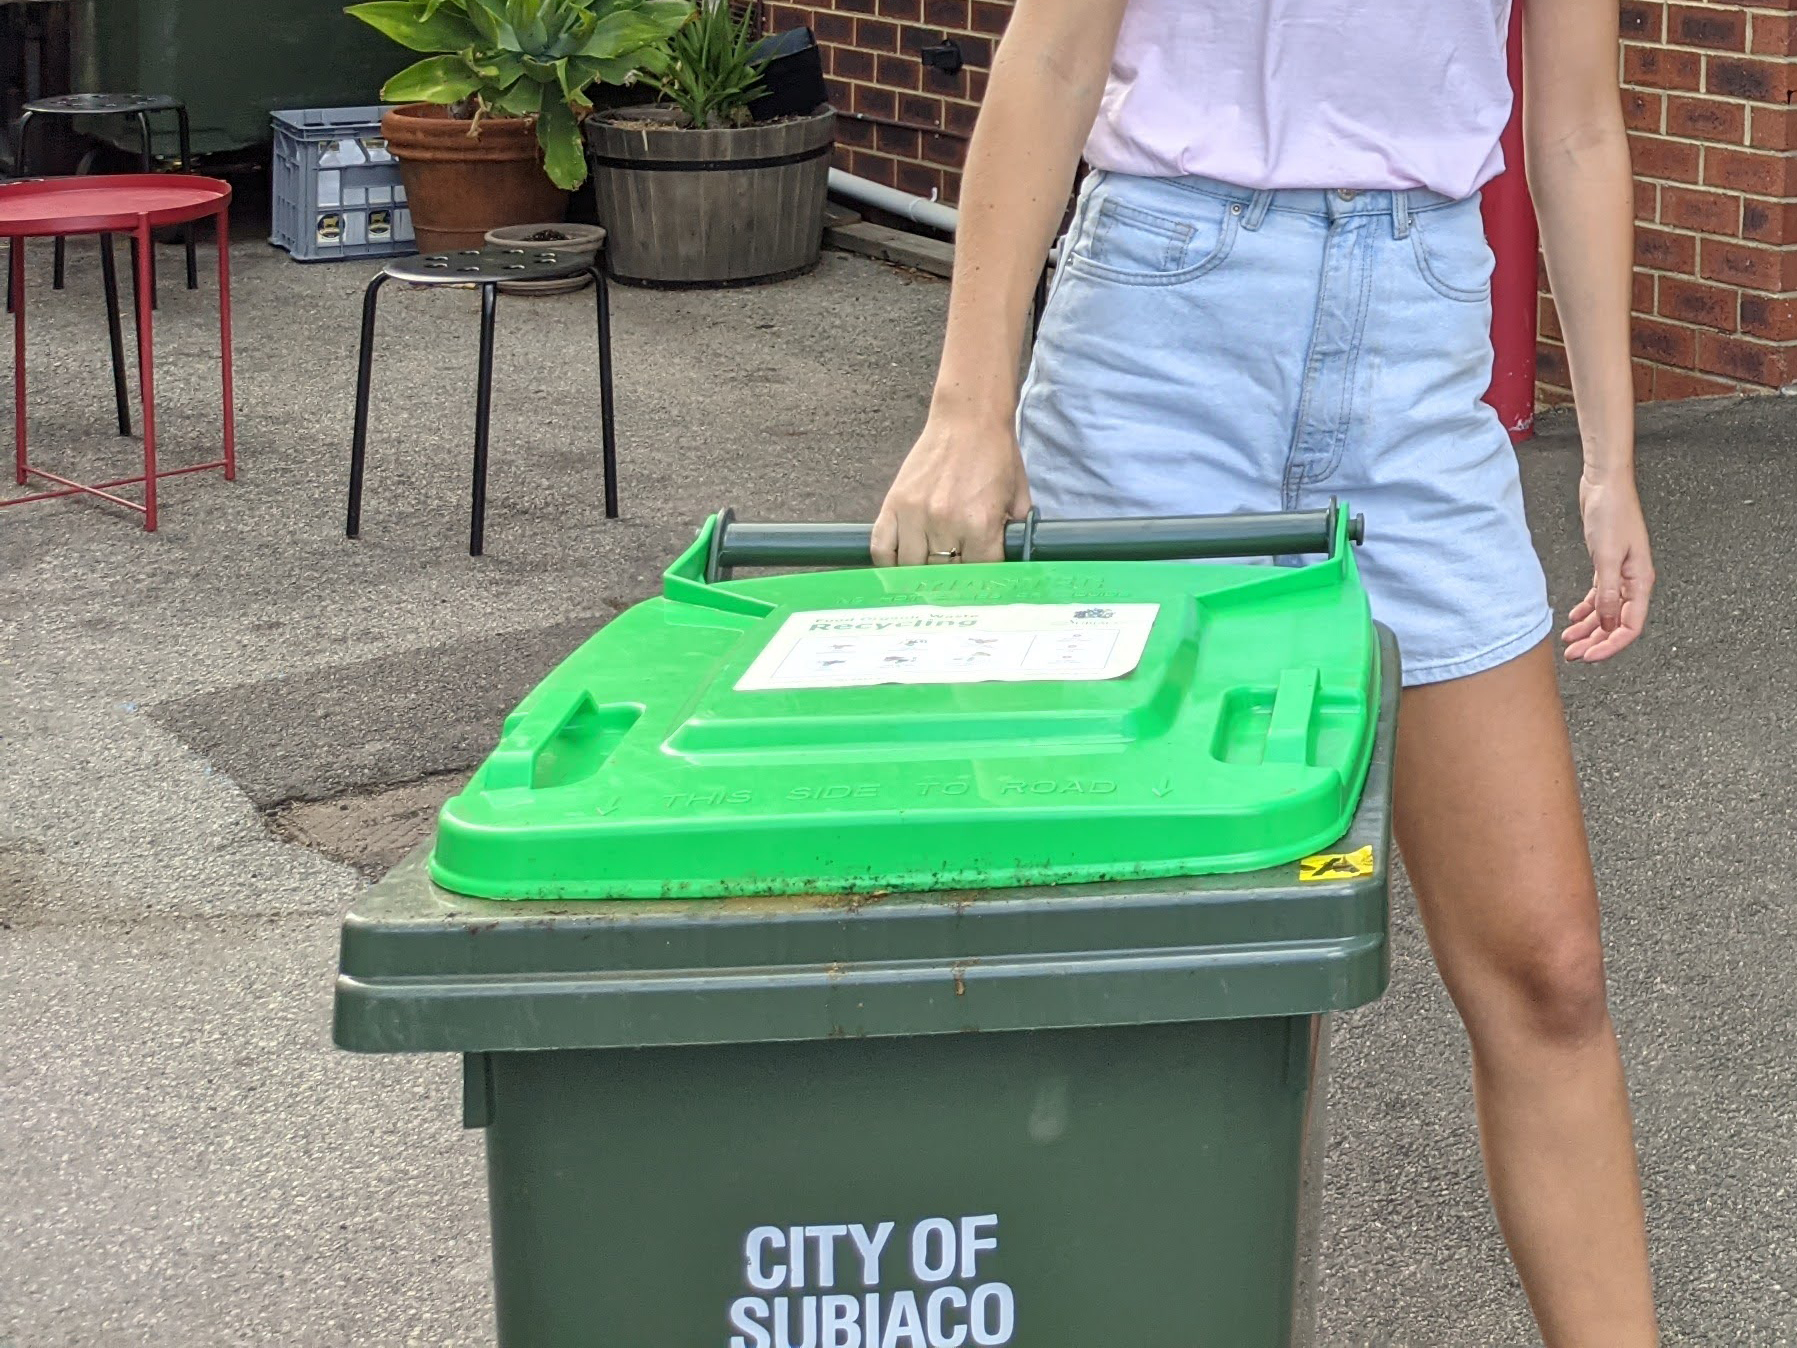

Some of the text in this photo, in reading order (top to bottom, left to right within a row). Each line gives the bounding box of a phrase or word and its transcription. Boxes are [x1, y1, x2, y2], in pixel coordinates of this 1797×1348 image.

[808, 619, 978, 631] Recycling
[662, 780, 1118, 808] THIS SIDE TO ROAD
[746, 1214, 998, 1289] CITY OF
[730, 1282, 1015, 1348] SUBIACO
